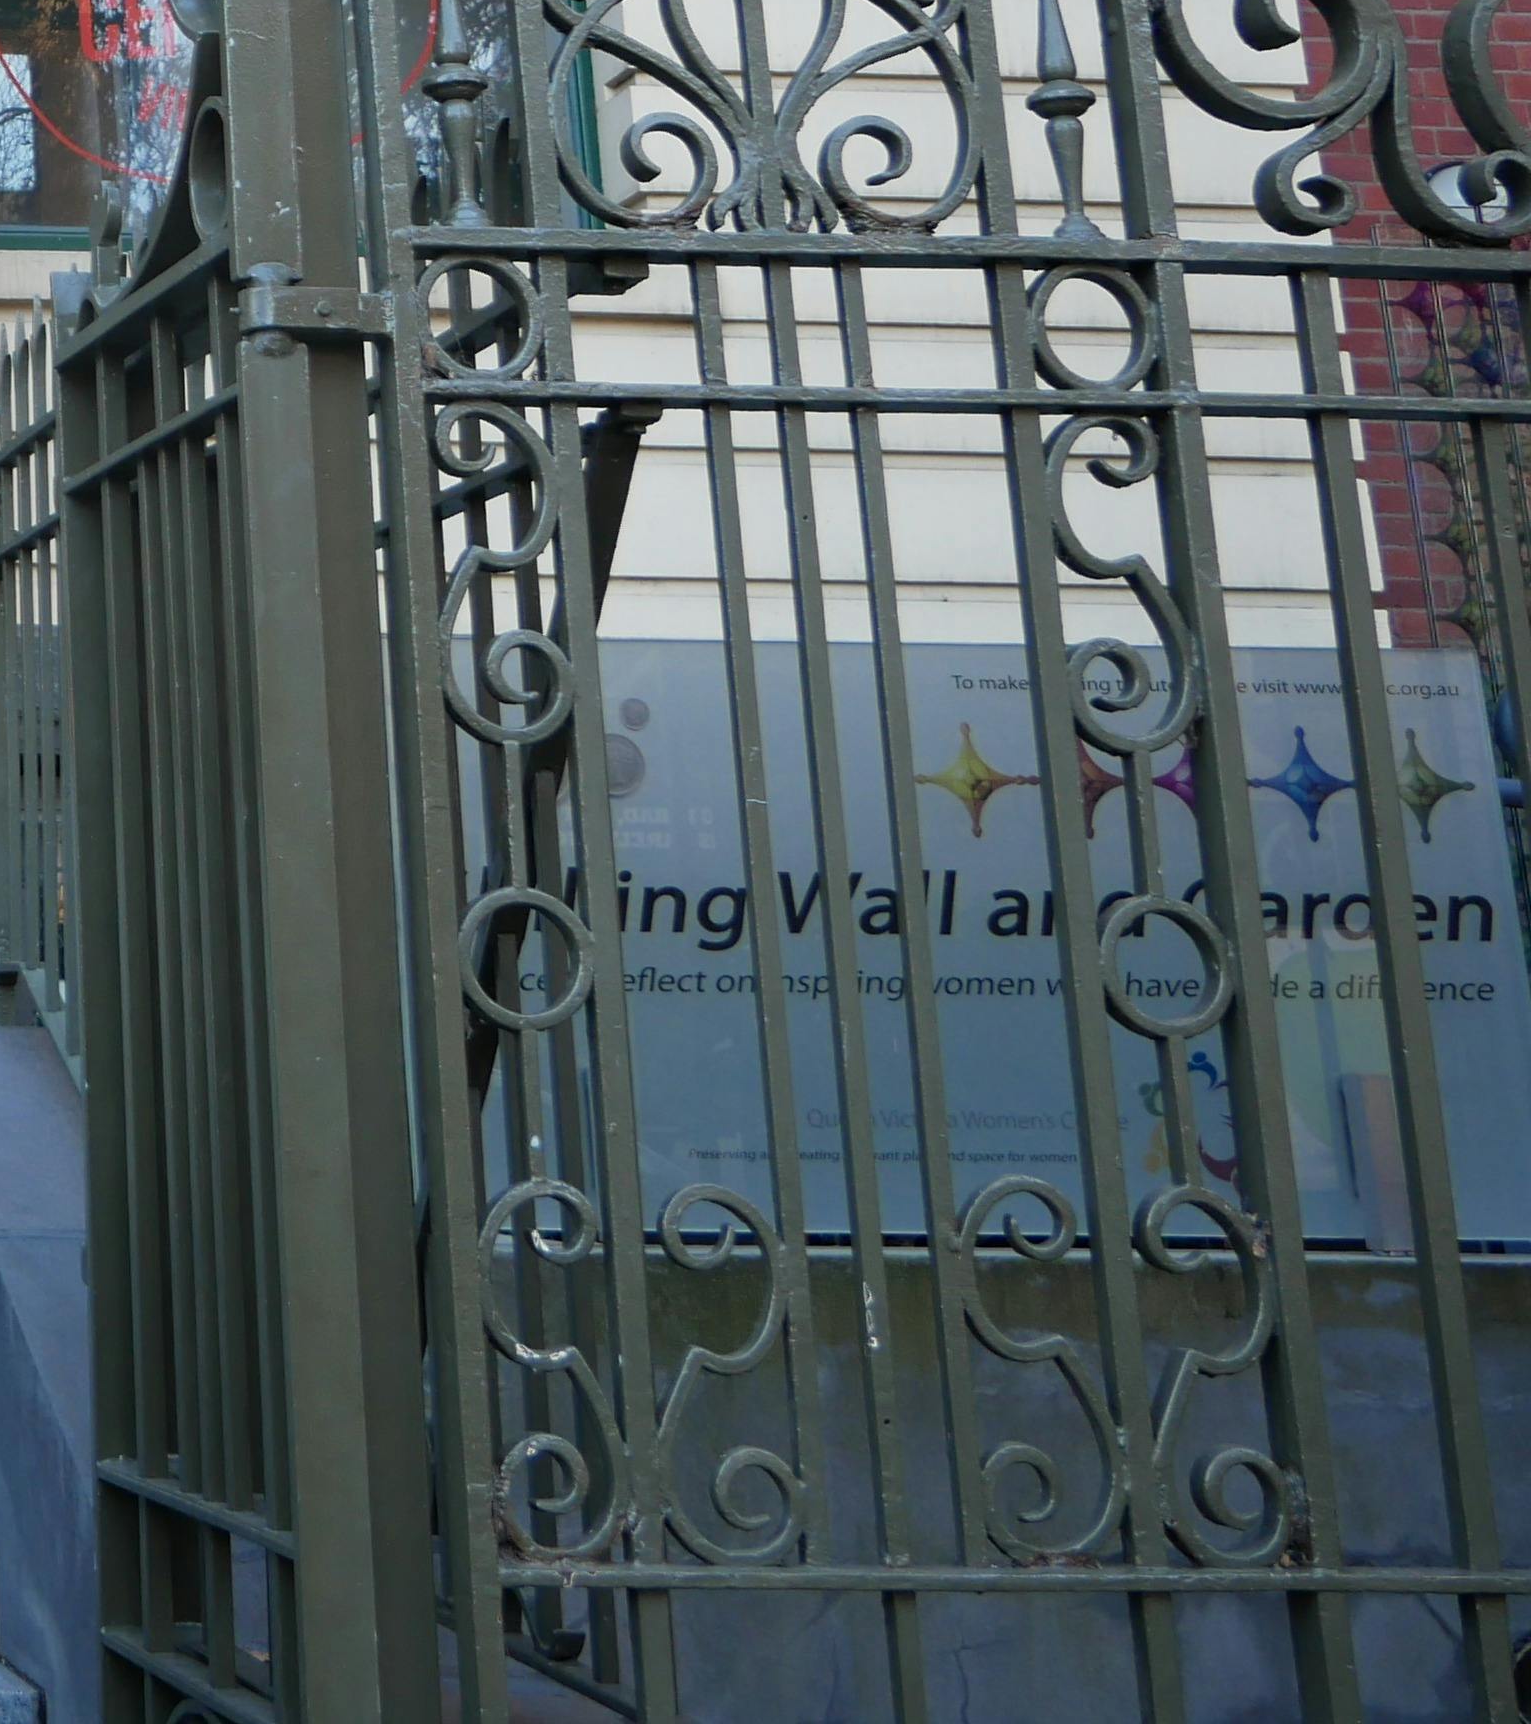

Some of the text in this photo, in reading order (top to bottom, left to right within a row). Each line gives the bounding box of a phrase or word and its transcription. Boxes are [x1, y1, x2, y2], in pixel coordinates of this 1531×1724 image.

[952, 675, 973, 690] To
[979, 675, 1029, 691] make
[1251, 679, 1290, 694] visit
[623, 966, 706, 993] eflect
[1125, 971, 1200, 997] have
